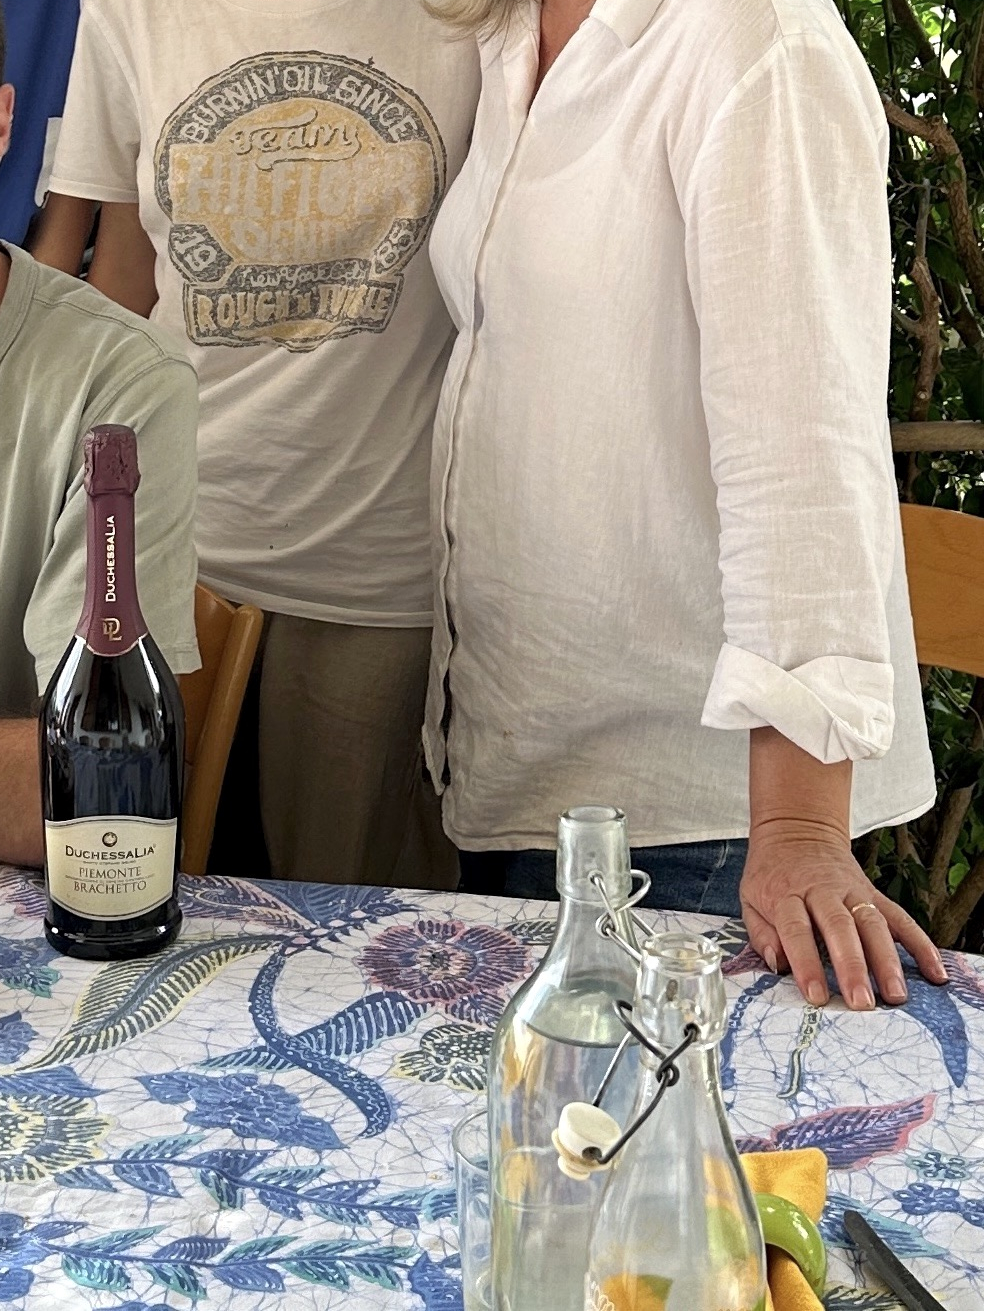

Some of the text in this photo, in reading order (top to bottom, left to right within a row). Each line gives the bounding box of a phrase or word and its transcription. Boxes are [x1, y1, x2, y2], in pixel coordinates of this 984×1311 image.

[282, 66, 330, 94] OIL
[336, 74, 418, 143] SINCE
[169, 231, 217, 271] 19
[194, 288, 290, 332] ROUGH
[74, 880, 147, 894] BRACHETTO
[79, 866, 142, 879] PIEMONTE
